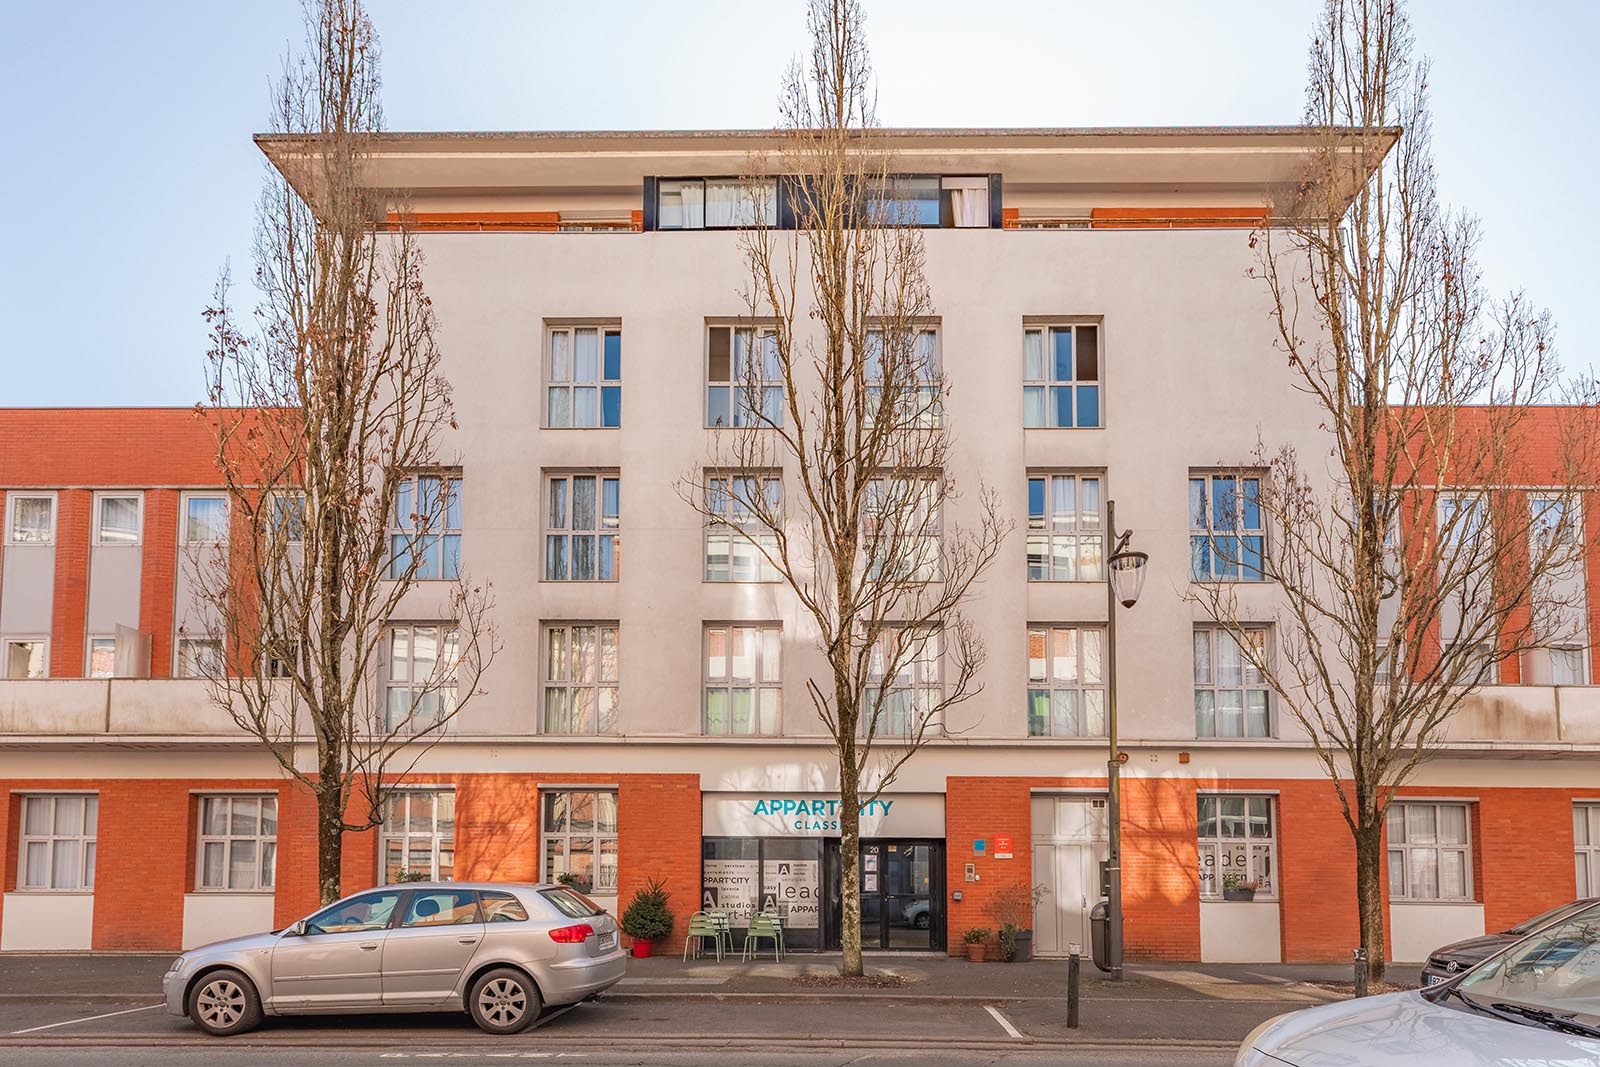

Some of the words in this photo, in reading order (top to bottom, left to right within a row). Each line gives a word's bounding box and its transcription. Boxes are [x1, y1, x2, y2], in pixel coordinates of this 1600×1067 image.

[754, 800, 894, 816] APPART'ITY
[795, 821, 844, 830] CLASSI
[870, 846, 879, 854] 20
